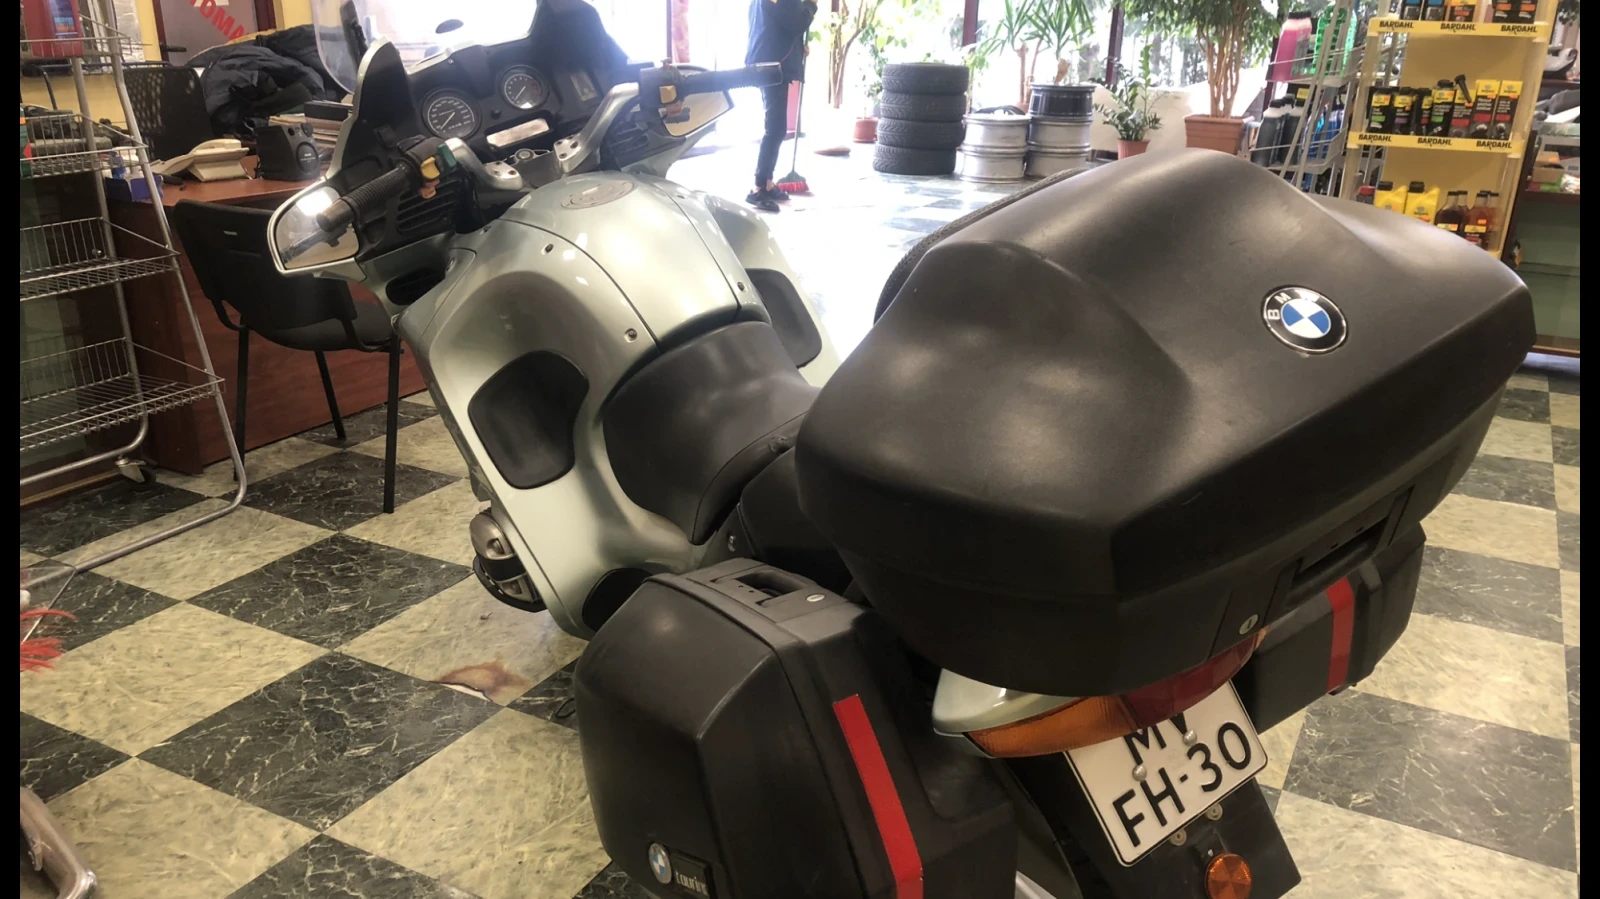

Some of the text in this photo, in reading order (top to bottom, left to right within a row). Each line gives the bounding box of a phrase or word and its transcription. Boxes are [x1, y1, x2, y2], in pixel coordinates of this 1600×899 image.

[190, 0, 245, 40] OMA
[1379, 20, 1414, 30] BARDAHL
[1440, 23, 1476, 32] BARDAHL
[1501, 25, 1538, 34] BARDAHL
[1358, 134, 1392, 143] BARDAHL
[1417, 137, 1452, 147] BARDAHL
[1476, 140, 1512, 150] BARDAHL
[1112, 721, 1252, 848] FH-30
